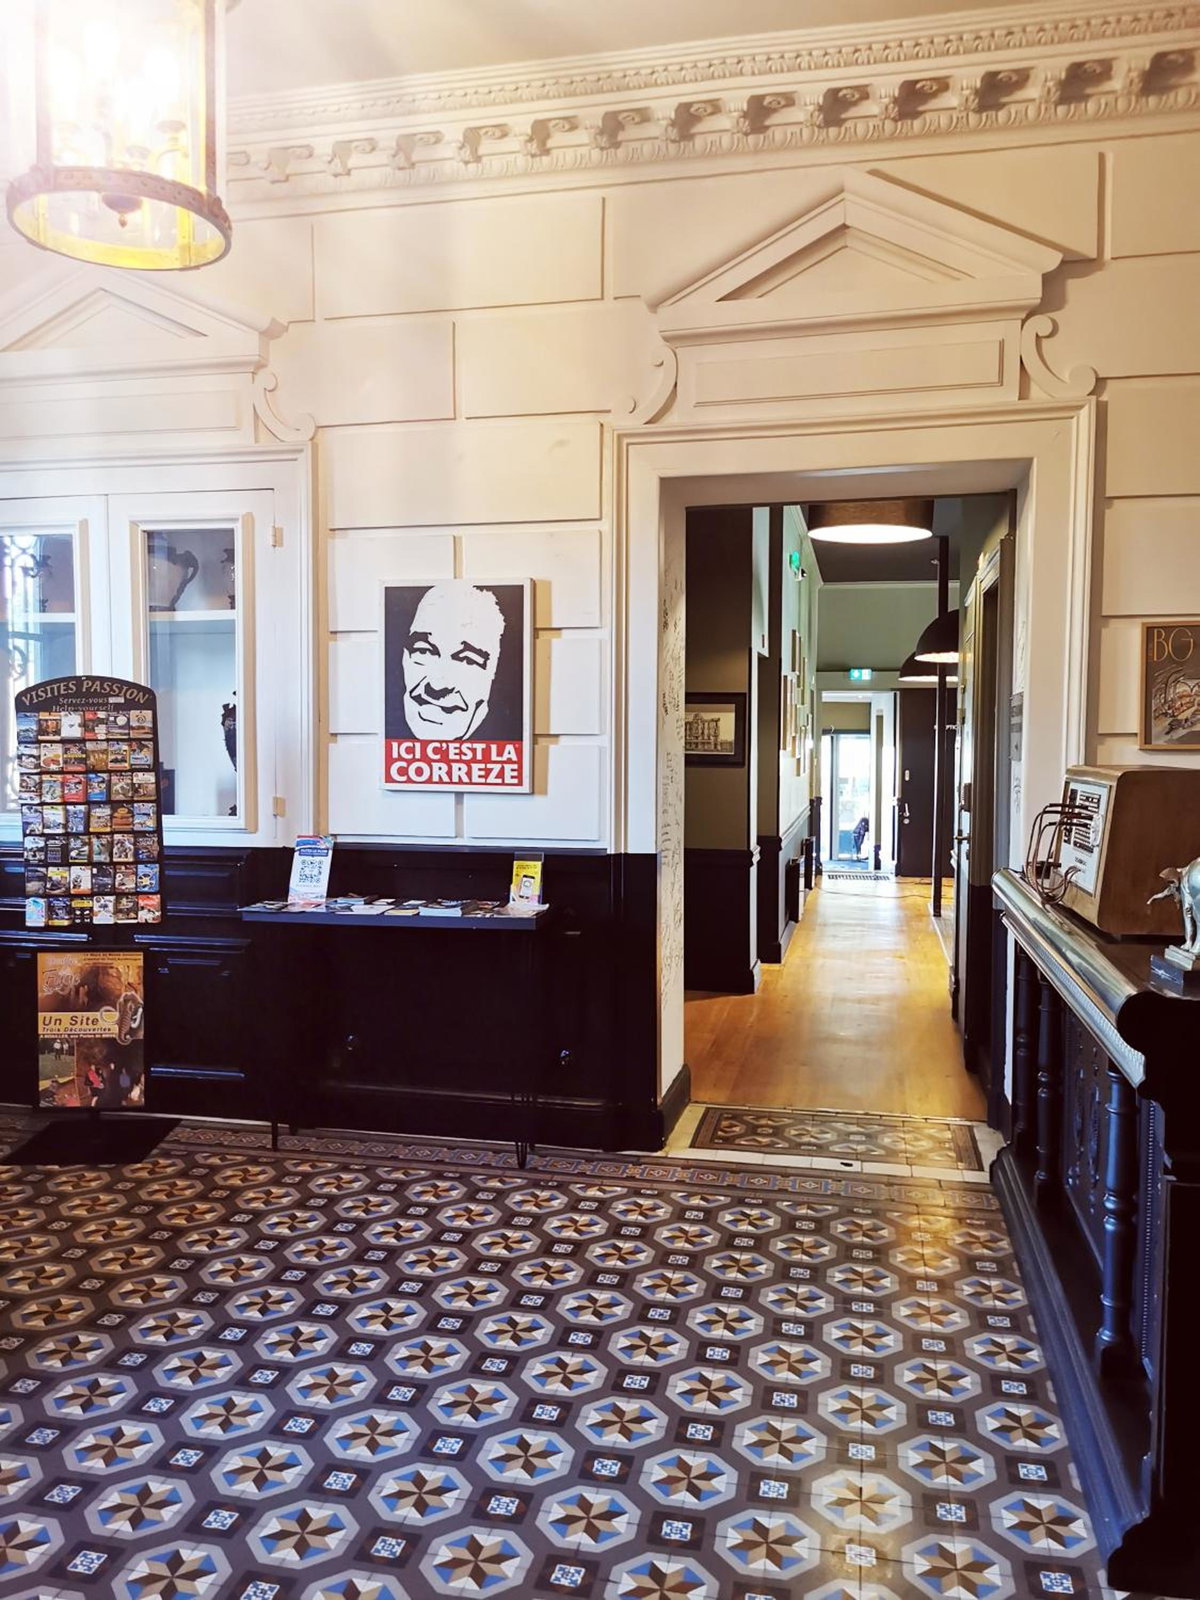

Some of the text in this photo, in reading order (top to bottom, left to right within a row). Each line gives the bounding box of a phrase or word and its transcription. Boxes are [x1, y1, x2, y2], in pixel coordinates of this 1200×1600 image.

[21, 680, 149, 706] VISITES PASSION
[391, 742, 518, 762] ICI C'EST LA
[389, 761, 519, 784] CORREZE
[42, 1015, 99, 1026] Un Site
